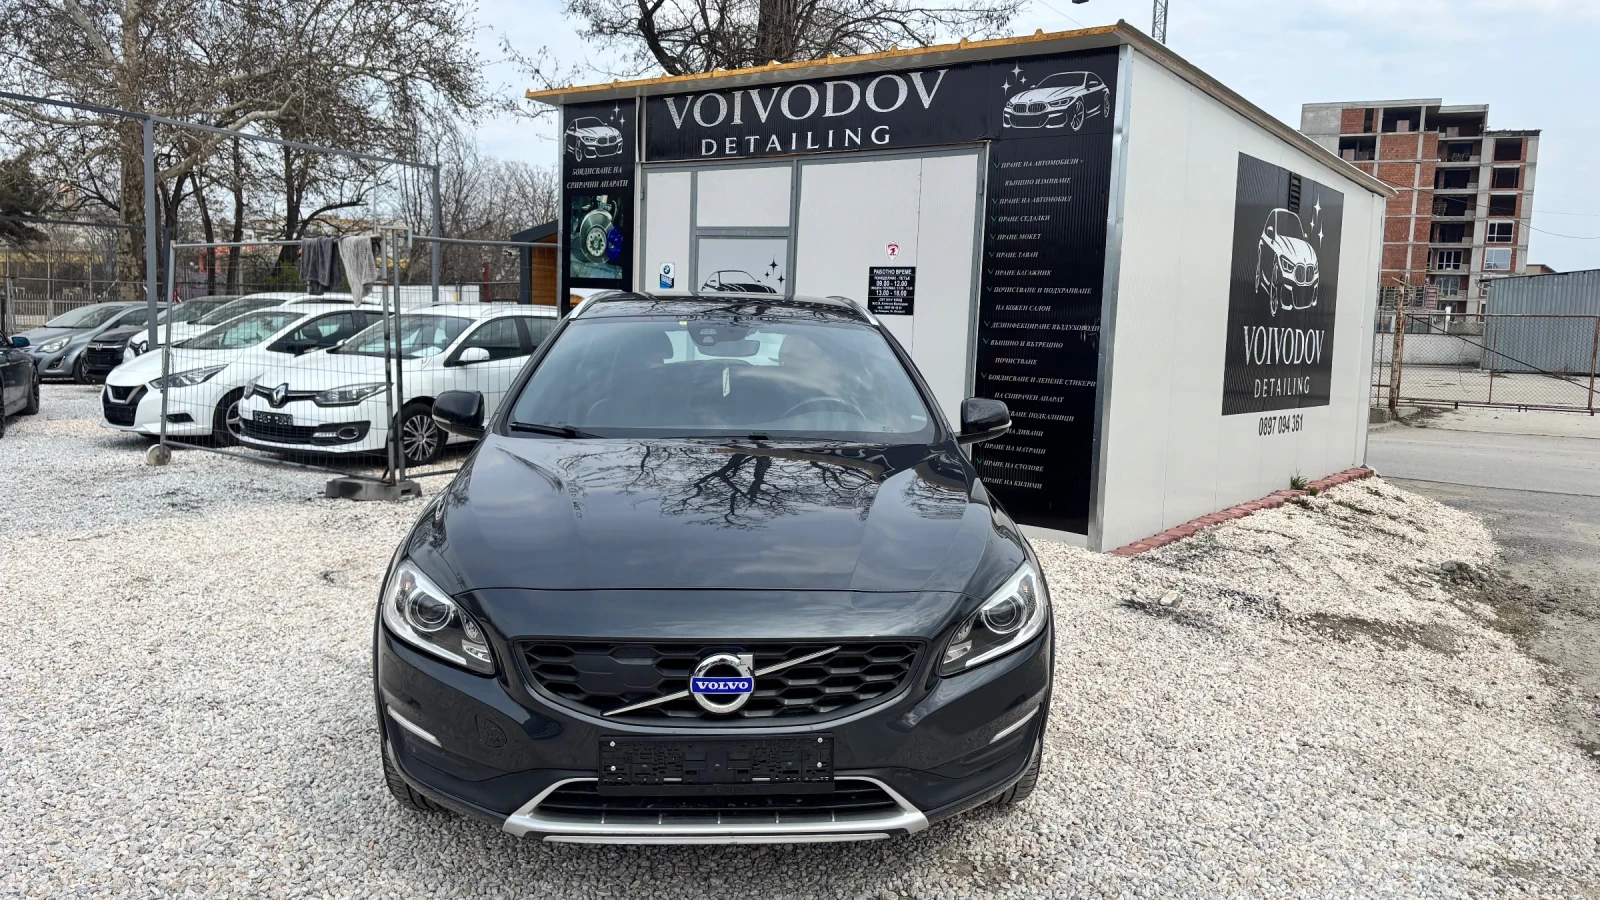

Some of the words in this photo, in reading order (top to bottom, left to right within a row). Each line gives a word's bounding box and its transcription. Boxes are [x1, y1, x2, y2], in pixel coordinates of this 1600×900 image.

[664, 69, 949, 130] VOIVODOV
[701, 126, 890, 156] DETAILING
[1034, 158, 1079, 167] АВТОМОБИЛИ
[572, 166, 612, 176] БОЯДИСВАНЕ
[566, 180, 600, 189] СПИРАЧНИ
[600, 180, 628, 188] АПАРАТИ
[990, 322, 1051, 330] ДЕЗИНФЕКЦИРАНЕ
[1243, 326, 1324, 366] VOIVODOV
[988, 374, 1030, 382] БОЯДИСВАНЕ
[1254, 376, 1310, 398] DETAILING
[1004, 392, 1038, 400] СПИРАЧЕН
[1028, 412, 1074, 422] ПОДКАЛНИЦИ
[1258, 416, 1277, 436] 0897
[1278, 415, 1290, 434] 094
[1292, 414, 1303, 432] 361
[1016, 446, 1046, 455] МАТРАЦИ
[1015, 463, 1044, 472] СТОЛОВЕ
[1014, 480, 1042, 489] КИЛИМИ
[695, 680, 749, 690] VOLVO
